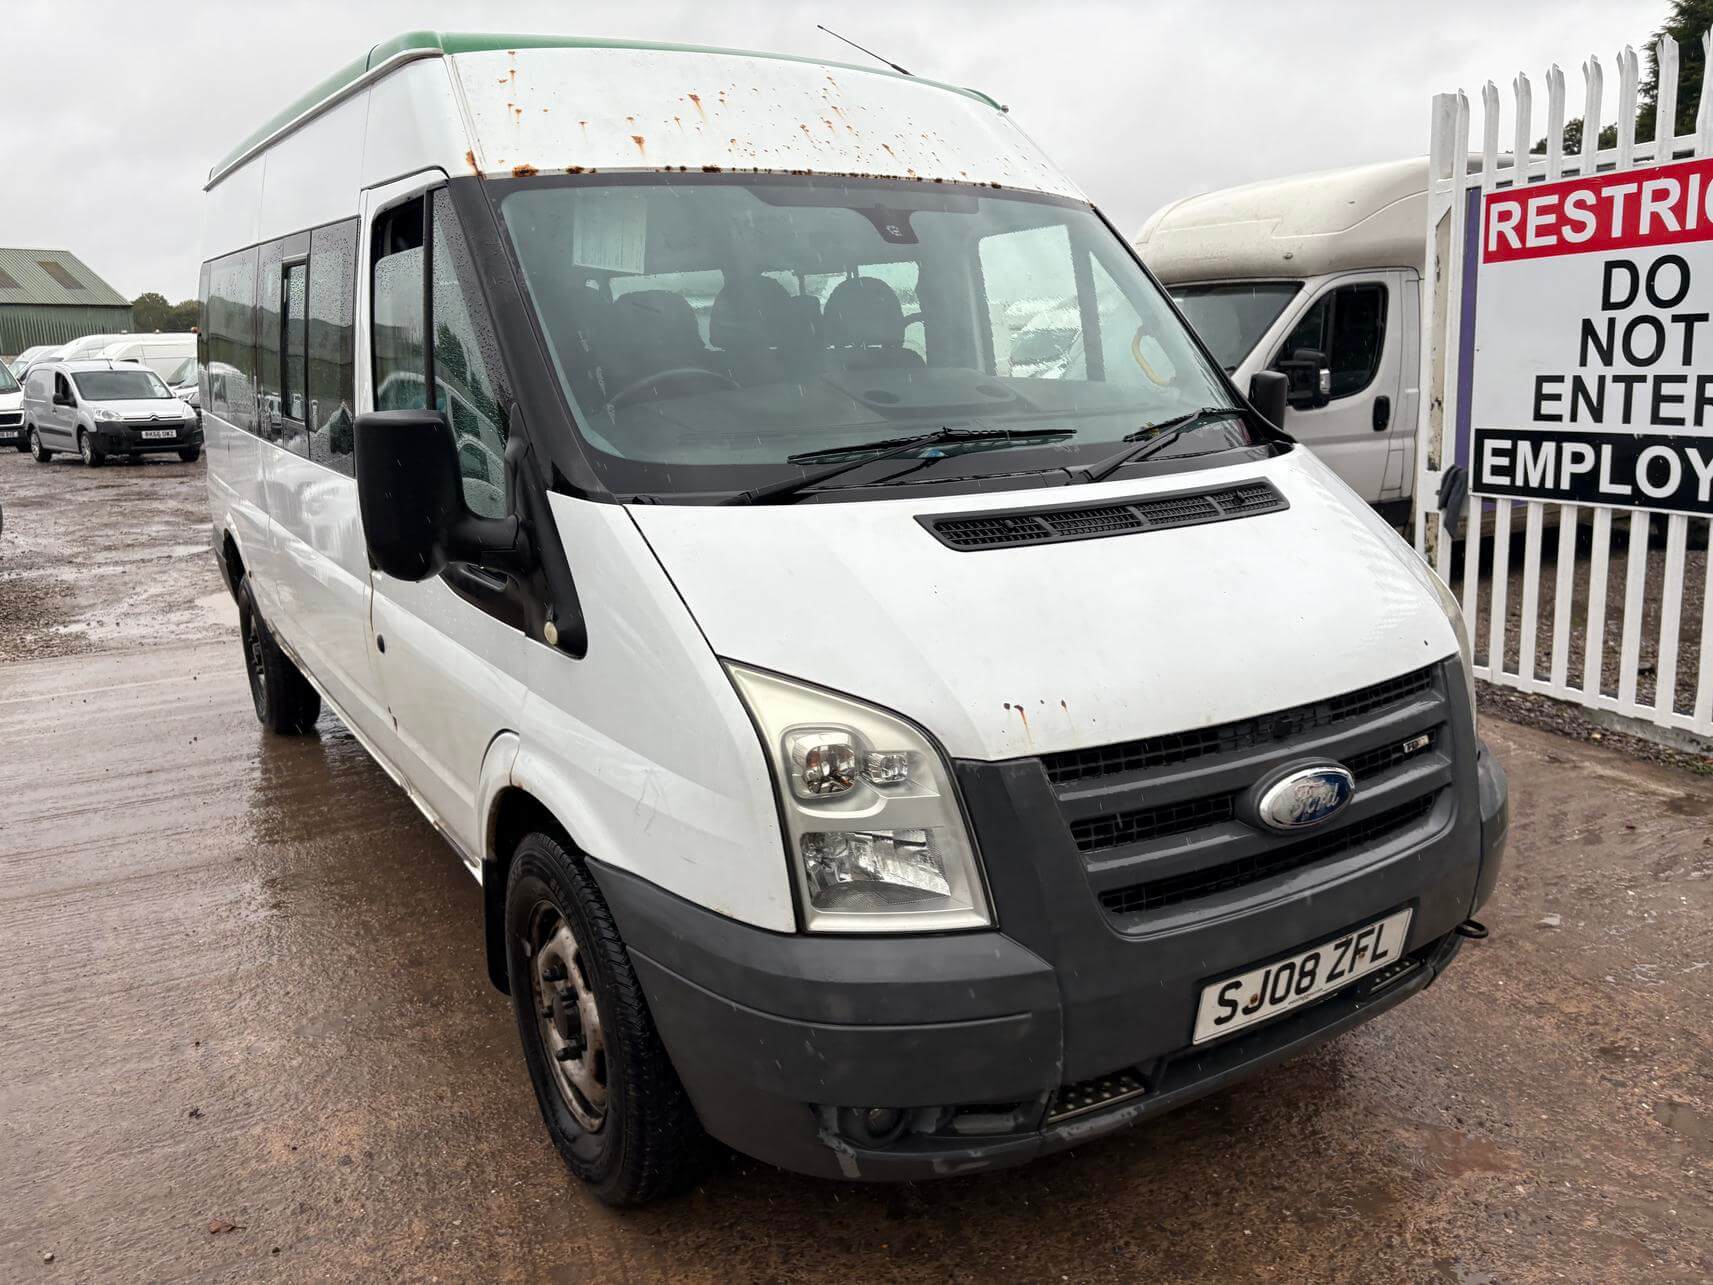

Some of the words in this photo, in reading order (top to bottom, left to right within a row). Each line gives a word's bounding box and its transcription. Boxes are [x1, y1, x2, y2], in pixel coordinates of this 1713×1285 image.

[1488, 173, 1713, 252] RESTRI
[1601, 254, 1691, 311] DO
[1579, 313, 1709, 367] NOT
[1213, 952, 1321, 1026] SJ08
[1325, 923, 1388, 984] ZFL
